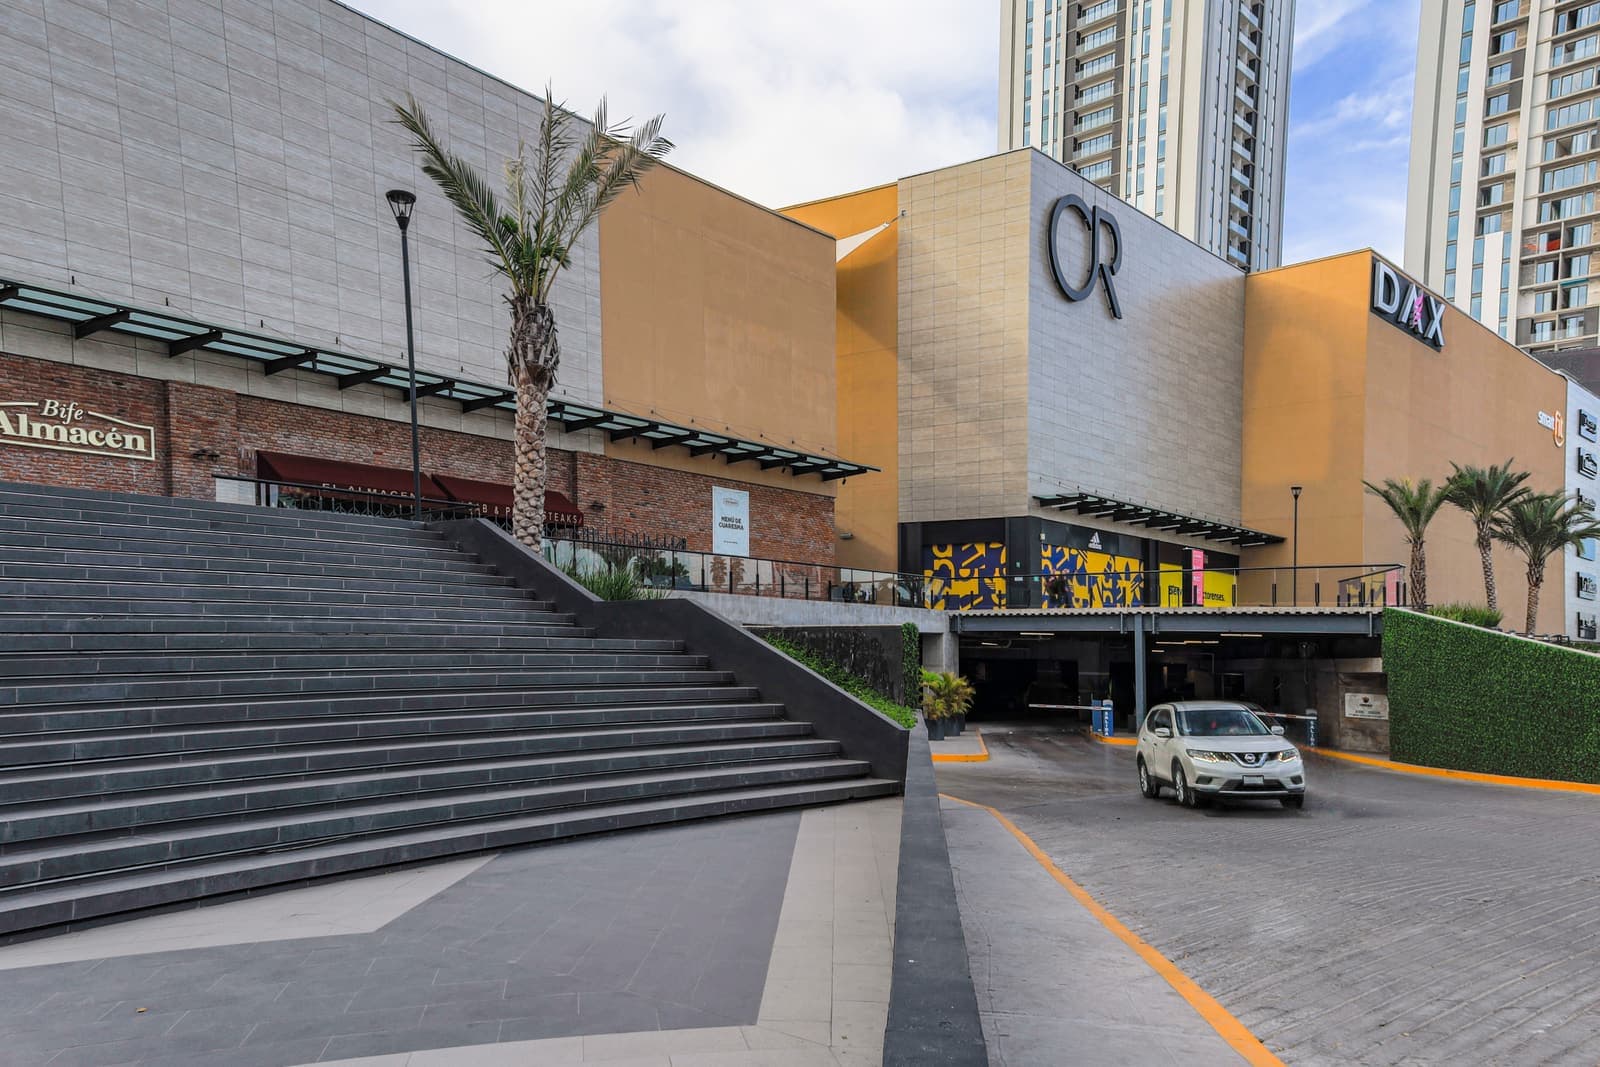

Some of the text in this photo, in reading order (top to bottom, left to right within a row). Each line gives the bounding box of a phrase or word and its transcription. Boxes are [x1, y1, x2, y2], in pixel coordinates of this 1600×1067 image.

[1374, 261, 1446, 346] DAX
[0, 410, 147, 452] Almacén
[40, 399, 85, 425] Bife
